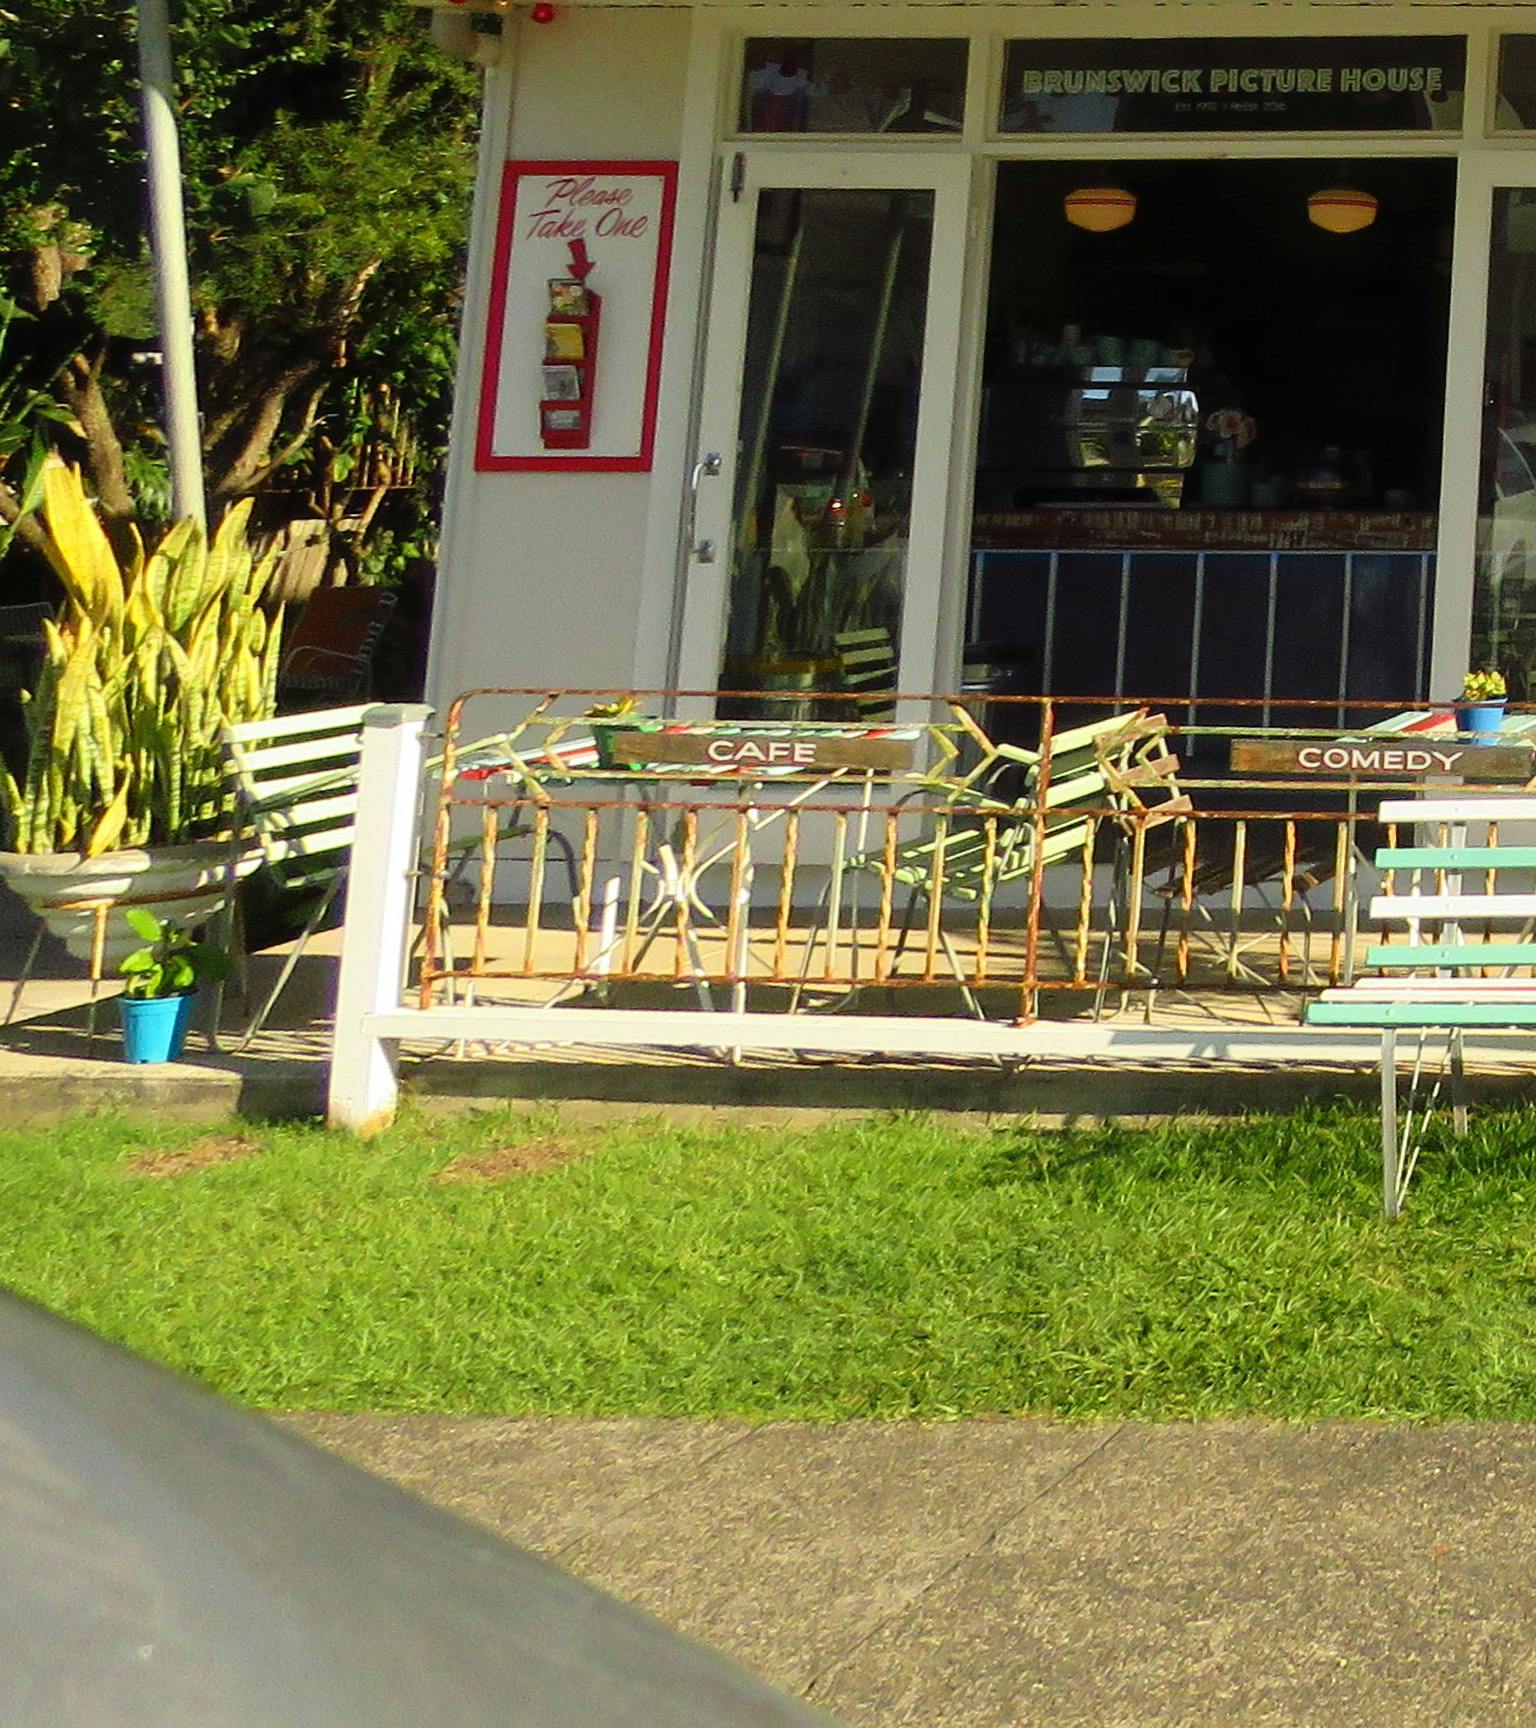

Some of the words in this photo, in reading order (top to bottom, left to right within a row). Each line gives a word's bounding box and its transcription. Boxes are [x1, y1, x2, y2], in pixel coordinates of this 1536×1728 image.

[1023, 70, 1201, 94] BRUNSWICK
[1210, 68, 1332, 92] PICTURE
[1340, 68, 1442, 91] HOUSE
[546, 176, 633, 207] Please
[526, 209, 588, 239] Take
[595, 207, 648, 237] One
[708, 740, 817, 763] CAFE
[1298, 747, 1463, 772] COMEDY
